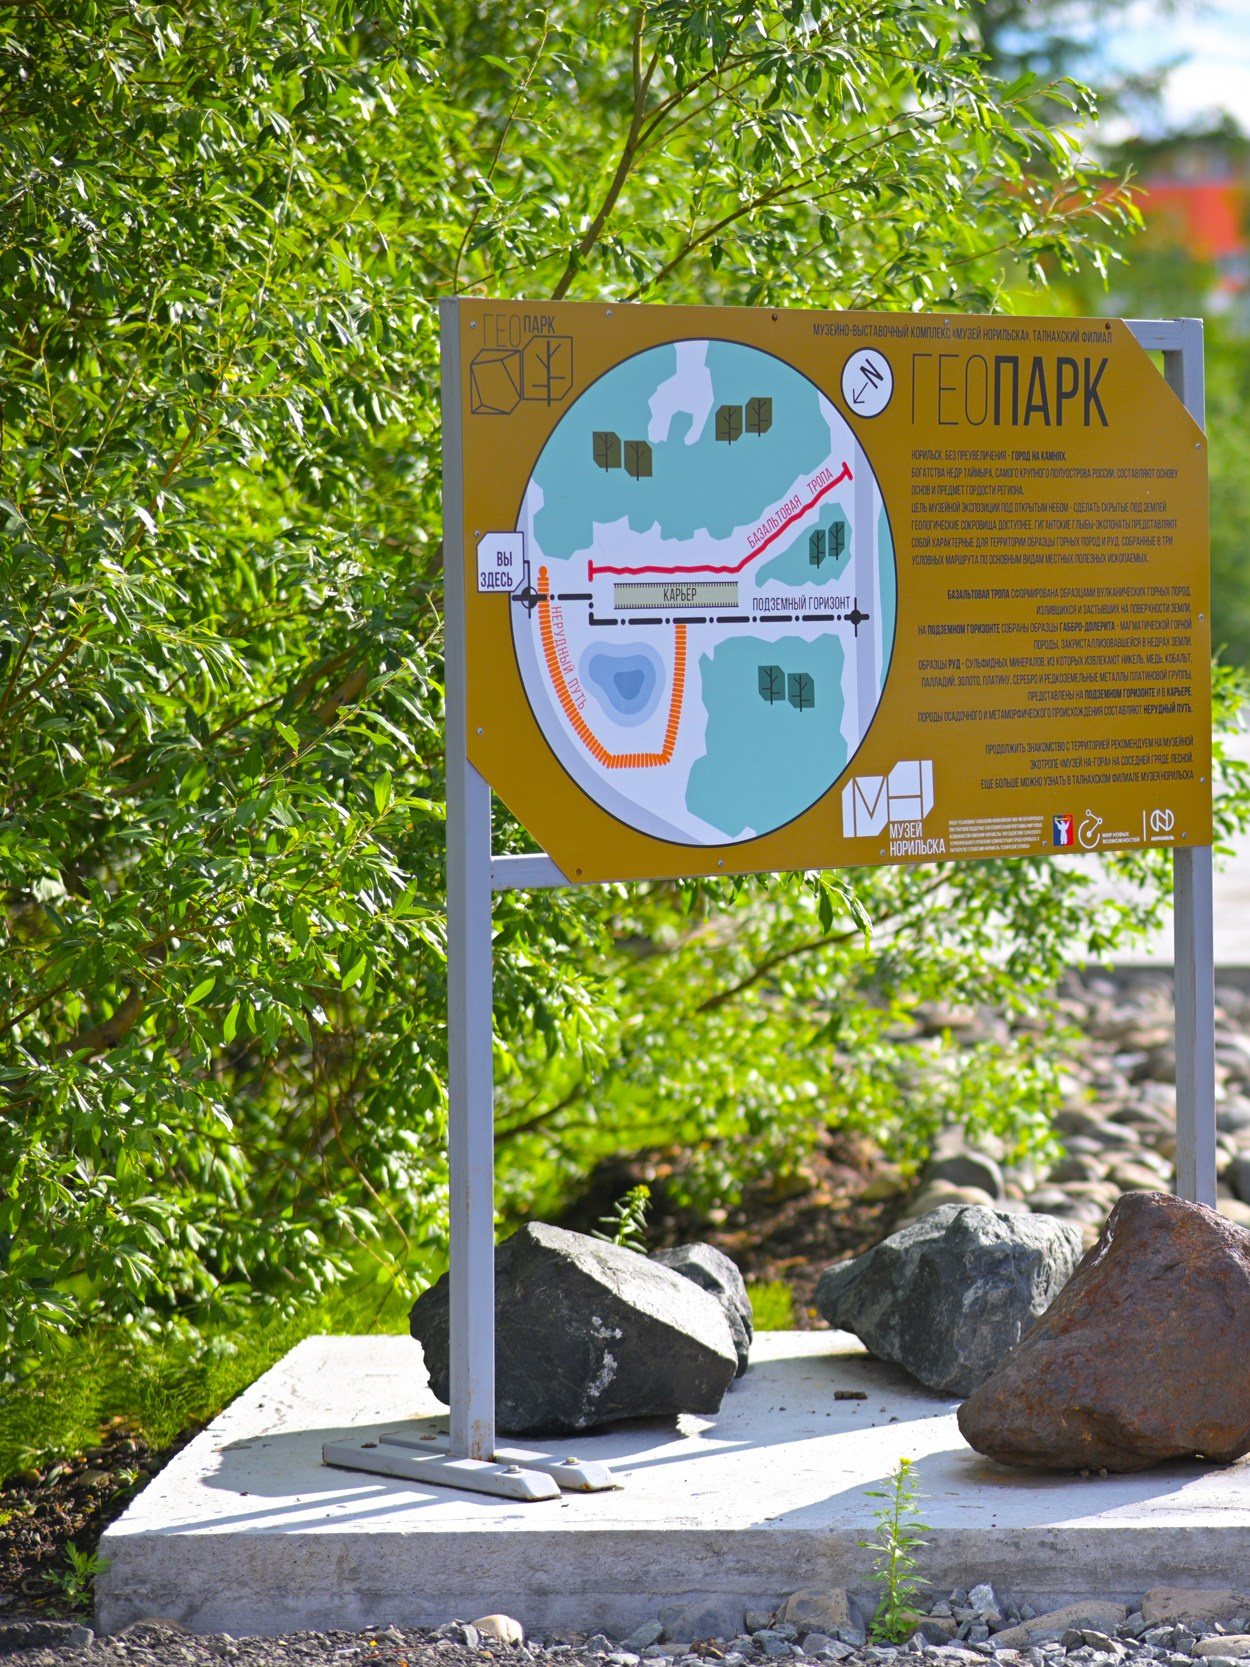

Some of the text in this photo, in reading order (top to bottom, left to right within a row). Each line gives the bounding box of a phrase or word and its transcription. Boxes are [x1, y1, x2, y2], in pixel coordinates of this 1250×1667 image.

[813, 323, 909, 338] МУЗЕЙНО-ВЫСТАВОЧНЫЙ
[911, 327, 950, 339] КОМПЛЕКС
[1033, 328, 1080, 343] ТАЛНАХСКИЙ
[1081, 331, 1112, 344] ФИЛИАЛ
[859, 358, 884, 389] N
[912, 353, 1109, 427] ГЕОПАРК
[945, 450, 956, 461] БЕЗ
[958, 450, 1007, 461] ПРЕУВЕЛИЧЕНИЯ
[1011, 450, 1031, 461] ГОРОД
[911, 467, 945, 478] БОГАТСТВА
[946, 468, 962, 479] НЕДР
[995, 468, 1019, 478] САМОГО
[1019, 468, 1050, 479] КРУПНОГО
[1051, 468, 1091, 479] ПОЛУОСТРОВА
[1116, 468, 1155, 479] СОСТАВЛЯЮТ
[1156, 468, 1179, 479] ОСНОВУ
[911, 485, 931, 496] ОСНОВ
[937, 485, 965, 496] ПРЕДМЕТ
[965, 485, 997, 496] ГОРДОСТИ
[747, 467, 834, 549] БАЗАЛЬТОВАЯ ТРОПА
[911, 501, 1167, 513] ЦЕЛЬ МУЗЕЙНОЙ ЭКСПОЗИЦИИ ПОД ОТКРЫТЫМ НЕБОМ СДЕЛАТЬ СКРЫТЫЕ ПОД ЗЕМЛЕЙ
[911, 520, 960, 531] ГЕОЛОГИЧЕСКИЕ
[960, 520, 997, 531] СОКРОВИЩА
[1034, 519, 1071, 530] ГИГАНТСКИЕ
[1072, 519, 1131, 530] ГЛЫБЫ-ЭКСПОНАТЫ
[1131, 519, 1178, 530] ПРЕДСТАВЛЯЮТ
[911, 536, 931, 548] СОБОЙ
[932, 537, 974, 548] ХАРАКТЕРНЫЕ
[975, 537, 989, 548] ДЛЯ
[990, 537, 1026, 548] ТЕРРИТОРИИ
[1027, 537, 1055, 548] ОБРАЗЦЫ
[1056, 537, 1080, 547] ГОРНЫХ
[1081, 536, 1101, 548] ПОРОД
[1121, 536, 1156, 547] СОБРАННЫЕ
[1162, 536, 1173, 546] ТРИ
[497, 551, 513, 567] ВЫ
[911, 555, 944, 565] УСЛОВНЫХ
[945, 554, 979, 565] МАРШРУТА
[989, 554, 1022, 565] ОСНОВНЫМ
[1023, 554, 1044, 565] ВИДАМ
[1045, 553, 1074, 564] МЕСТНЫХ
[1075, 553, 1106, 564] ПОЛЕЗНЫХ
[480, 572, 513, 589] ЗДЕСЬ
[663, 588, 697, 602] КАРЬЕР
[947, 586, 1171, 600] БАЗАЛЬТОВАЯ ТРОПА СФОРМИРОВАНА ОБРАЗЦАМИ ВУЛКАНИЧЕСКИХ ГОРНЫХ
[752, 595, 851, 612] ПОДЗЕМНЫЙ ГОРИЗОНТ
[1036, 605, 1076, 616] ИЗЛИВШИХСЯ
[1083, 604, 1120, 615] ЗАСТЫВШИХ
[1130, 603, 1170, 614] ПОВЕРХНОСТИ
[928, 624, 966, 636] ПОДЗЕМНОМ
[967, 623, 1000, 635] ГОРИЗОНТЕ
[1001, 623, 1029, 634] СОБРАНЫ
[1030, 622, 1059, 634] ОБРАЗЦЫ
[1059, 621, 1115, 633] ГАББРО-ДОЛЕРИТА
[1120, 619, 1170, 631] МАГМАТИЧЕСКОЙ
[1170, 619, 1192, 630] ГОРНОЙ
[1147, 637, 1171, 648] НЕДРАХ
[551, 606, 588, 710] НЕРУДНЫЙ ПУТЬ
[919, 660, 947, 671] ОБРАЗЦЫ
[948, 659, 961, 670] РУД
[966, 658, 1008, 669] СУЛЬФИДНЫХ
[1056, 655, 1084, 666] КОТОРЫХ
[1085, 655, 1120, 665] ИЗВЛЕКАЮТ
[1013, 674, 1038, 685] СЕРЕБРО
[1044, 672, 1098, 684] РЕДКОЗЕМЕЛЬНЫЕ
[1100, 671, 1129, 682] МЕТАЛЛЫ
[1130, 669, 1167, 681] ПЛАТИНОВОЙ
[1028, 690, 1074, 702] ПРЕДСТАВЛЕНЫ
[1085, 688, 1122, 700] ПОДЗЕМНОМ
[1123, 688, 1155, 698] ГОРИЗОНТЕ
[918, 712, 943, 723] ПОРОДЫ
[944, 711, 982, 722] ОСАДОЧНОГО
[989, 708, 1052, 720] МЕТАМОРФИЧЕСКОГО
[1052, 706, 1104, 718] ПРОИСХОЖДЕНИЯ
[1105, 705, 1143, 716] СОСТАВЛЯЮТ
[1144, 702, 1176, 715] НЕРУДНЫЙ
[985, 743, 1026, 755] ПРОДОЛЖИТЬ
[1027, 742, 1065, 753] ЗНАКОМСТВО
[1071, 738, 1110, 751] ТЕРРИТОРИЕЙ
[1111, 737, 1154, 749] РЕКОМЕНДУЕМ
[1162, 735, 1194, 747] МУЗЕЙНОЙ
[1030, 758, 1059, 770] ЭКОТРОПЕ
[1121, 753, 1150, 766] СОСЕДНЕЙ
[1151, 754, 1169, 765] ГРЯДЕ
[981, 779, 994, 790] ЕЩЕ
[995, 778, 1019, 789] БОЛЬШЕ
[1020, 777, 1042, 787] МОЖНО
[1044, 775, 1066, 786] УЗНАТЬ
[1072, 773, 1111, 785] ТАЛНАХСКОМ
[1112, 772, 1140, 783] ФИЛИАЛЕ
[1141, 771, 1160, 782] МУЗЕЯ
[1160, 770, 1194, 781] НОРИЛЬСКА
[889, 821, 923, 839] МУЗЕЙ
[889, 838, 946, 857] НОРИЛЬСКА
